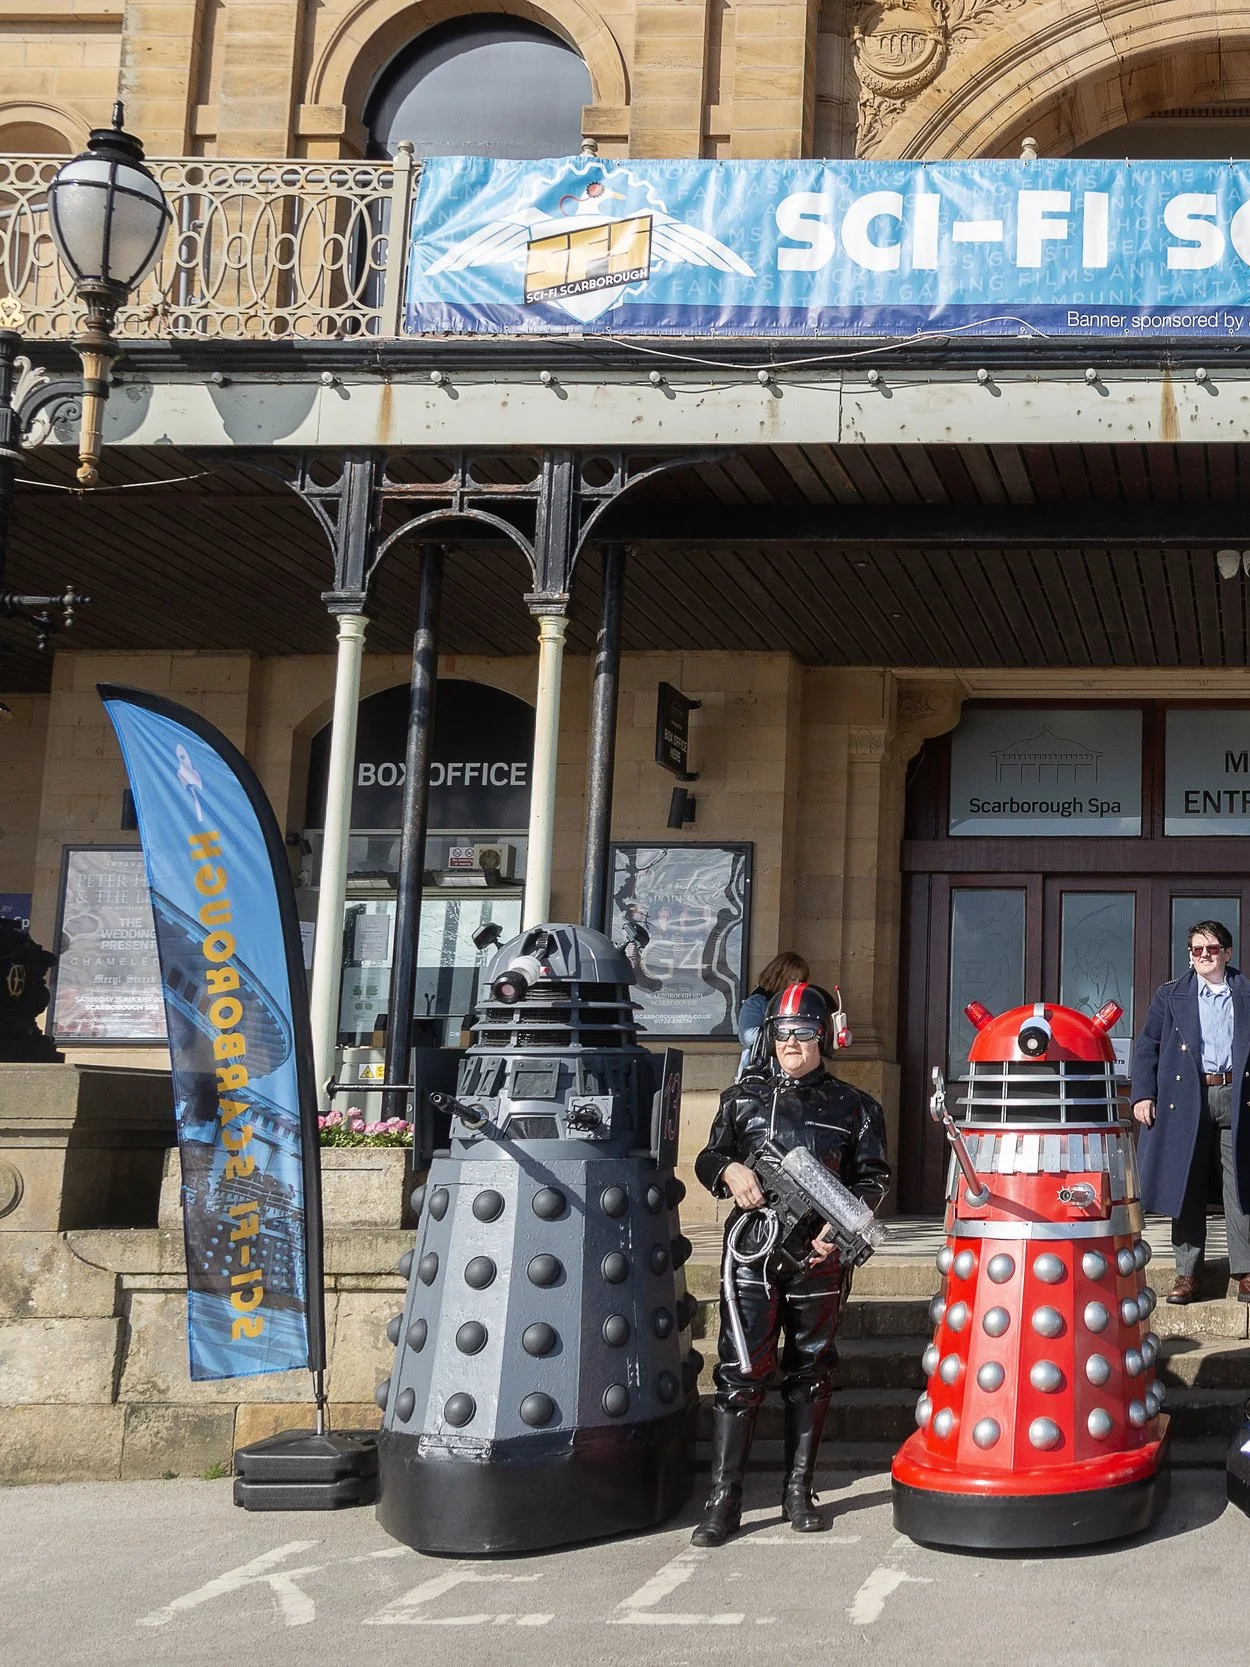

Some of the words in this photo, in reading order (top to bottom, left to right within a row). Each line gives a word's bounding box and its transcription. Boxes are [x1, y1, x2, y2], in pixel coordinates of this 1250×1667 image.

[776, 190, 1109, 272] SCI-FI
[526, 288, 558, 304] SCI-FI
[560, 269, 648, 297] SCARBOROUGH
[1067, 310, 1126, 328] Banner
[1131, 310, 1219, 331] sponsored
[1223, 311, 1244, 331] by
[428, 762, 528, 787] OFFICE
[967, 796, 1083, 820] Scarborough
[1087, 797, 1122, 819] Spa
[77, 872, 128, 889] PETER
[75, 889, 89, 905] &
[96, 889, 129, 904] THE
[119, 917, 143, 929] THE
[101, 940, 158, 951] PRESENT
[640, 939, 712, 981] G4
[85, 1004, 142, 1012] SCARBOROUGH
